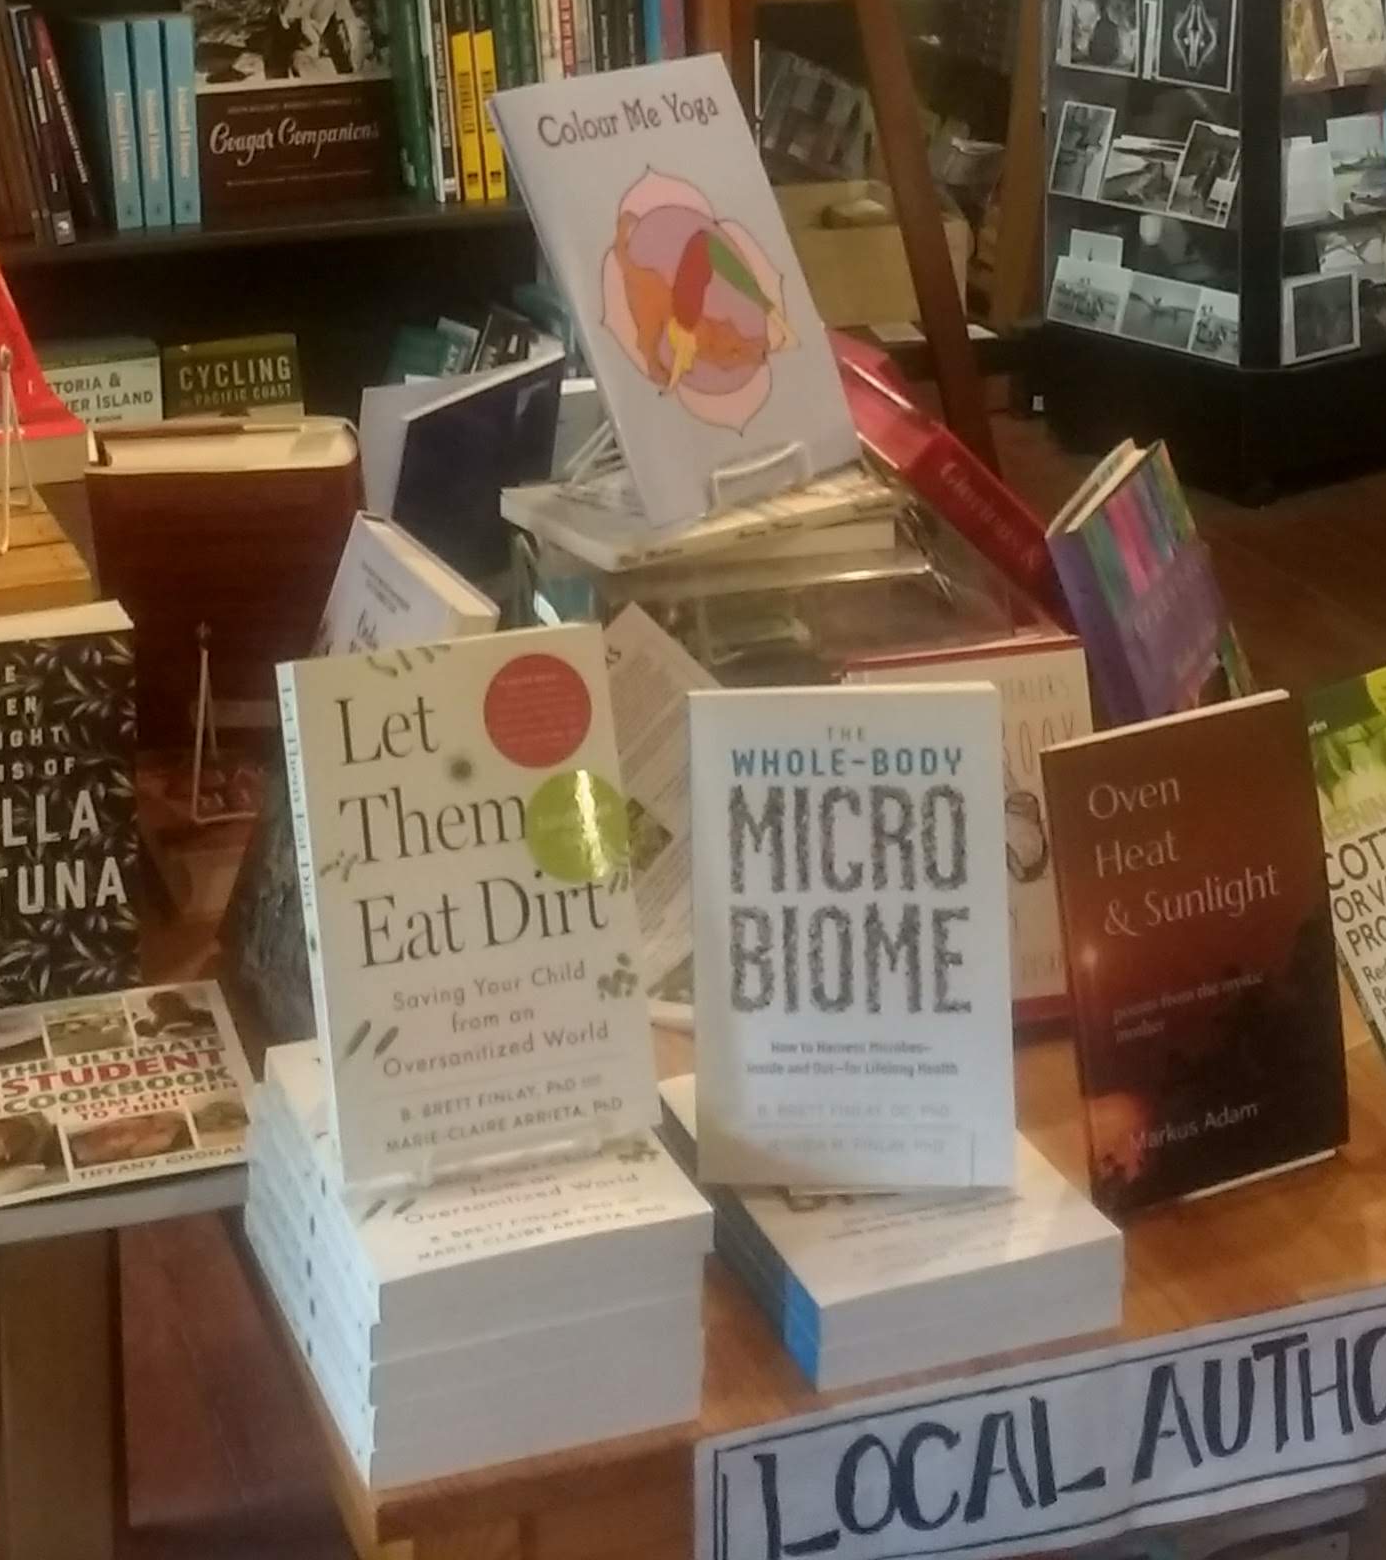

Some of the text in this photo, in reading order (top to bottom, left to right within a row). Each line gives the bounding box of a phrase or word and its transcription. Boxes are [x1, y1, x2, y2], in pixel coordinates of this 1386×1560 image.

[209, 116, 380, 167] Cougar Companions
[537, 92, 720, 149] Colour Me Yoga
[179, 356, 293, 392] CYCLING
[96, 390, 153, 409] ISLAND
[335, 693, 439, 766] Let
[825, 726, 867, 741] THE
[43, 756, 77, 777] OF
[731, 747, 964, 779] WHOLE-BODY
[1087, 774, 1181, 822] Oven
[338, 785, 526, 864] Them
[727, 783, 969, 894] MICRO
[1094, 830, 1181, 881] Heat
[355, 869, 610, 969] Eat Dirt
[1103, 863, 1281, 938] & Sunlight
[1333, 888, 1375, 926] OR
[729, 903, 972, 1014] BIOME
[392, 959, 586, 1013] Saving Your Child
[450, 1007, 536, 1035] from an
[382, 1020, 610, 1079] Oversanitized World
[771, 1040, 814, 1053] How to
[787, 1061, 959, 1075] and Health
[3, 1050, 224, 1098] STUDENT
[4, 1065, 236, 1113] COOKBOOK
[60, 1080, 239, 1115] FROM CHICKEN
[80, 1098, 182, 1121] TO CHILI
[422, 1091, 473, 1119] BRETT
[1130, 1098, 1261, 1150] Markus Adam
[752, 1394, 1108, 1560] LOCAL
